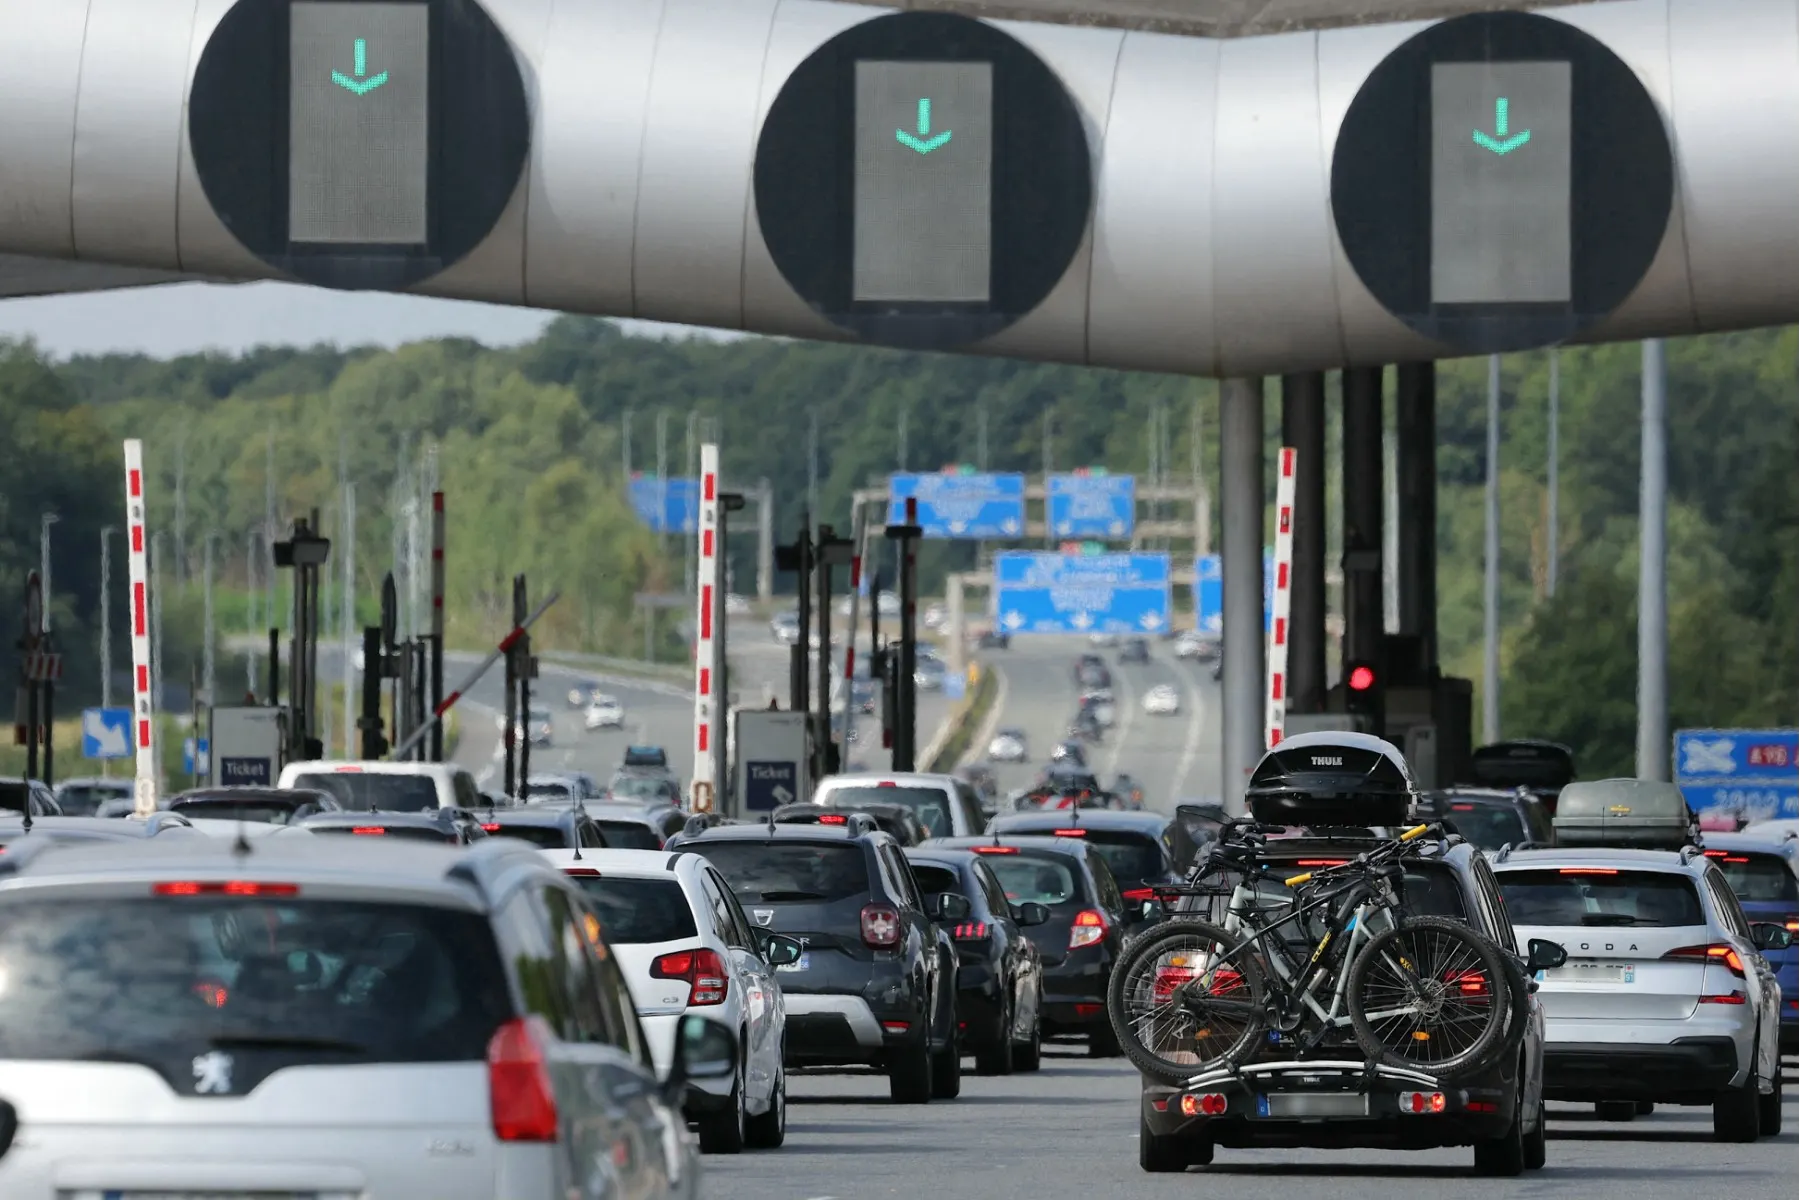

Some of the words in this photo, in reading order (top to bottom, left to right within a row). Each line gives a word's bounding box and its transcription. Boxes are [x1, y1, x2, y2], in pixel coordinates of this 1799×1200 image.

[1311, 757, 1342, 765] THULE
[226, 762, 264, 776] Ticket
[751, 765, 790, 779] Ticket
[1311, 930, 1333, 962] CUBE
